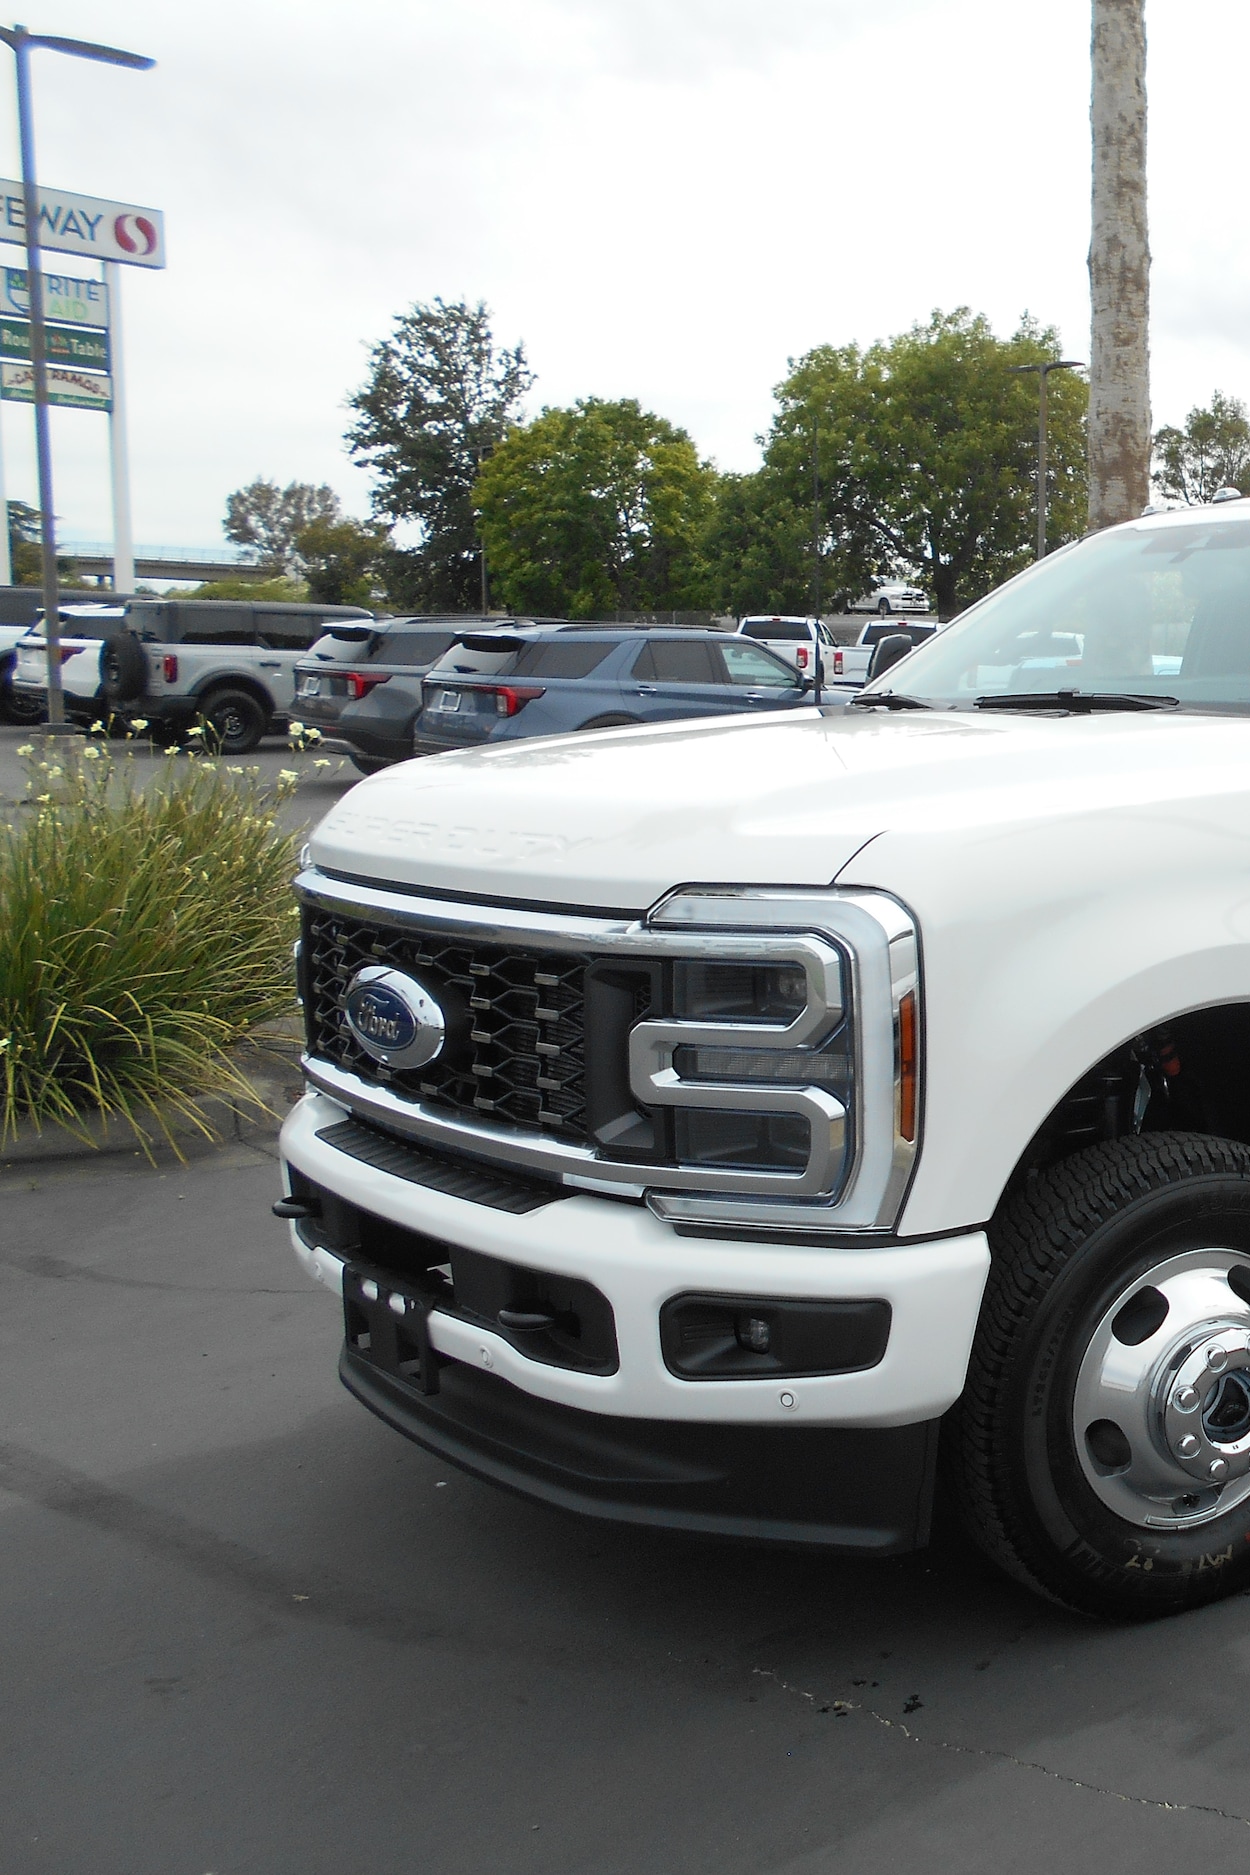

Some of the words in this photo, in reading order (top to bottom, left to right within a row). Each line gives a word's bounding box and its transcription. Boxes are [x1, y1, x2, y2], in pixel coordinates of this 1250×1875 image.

[0, 194, 103, 241] EWAY
[48, 276, 99, 301] RITE
[50, 301, 87, 320] AID
[70, 338, 107, 359] Table
[357, 992, 400, 1041] Ford
